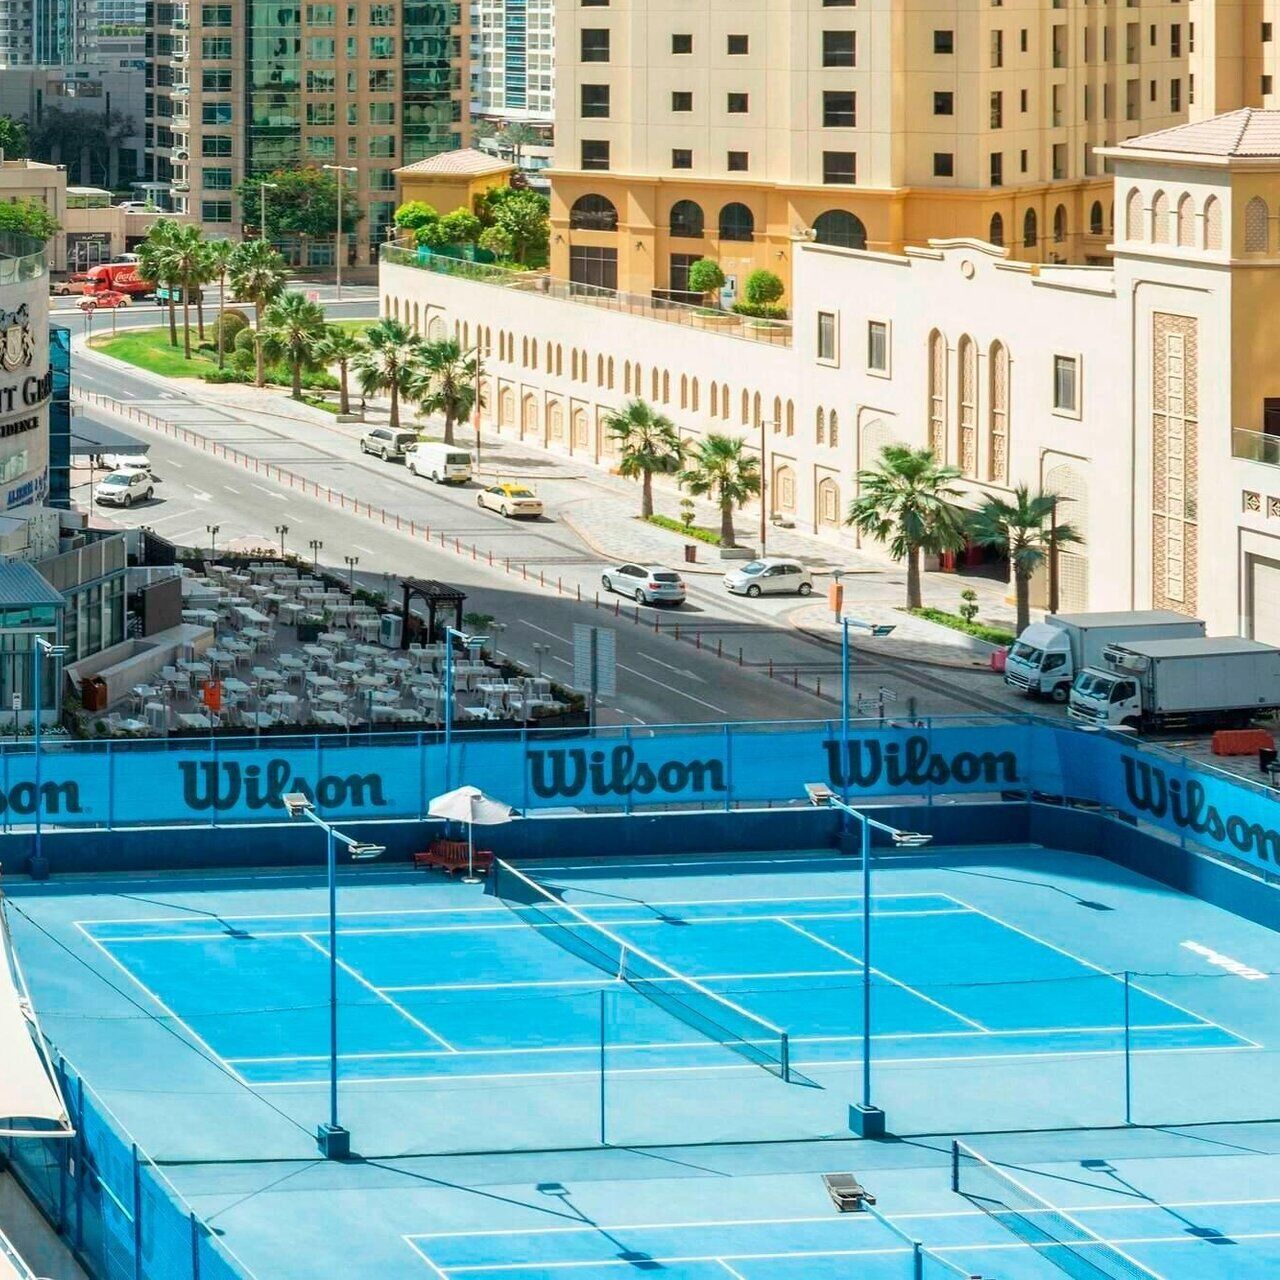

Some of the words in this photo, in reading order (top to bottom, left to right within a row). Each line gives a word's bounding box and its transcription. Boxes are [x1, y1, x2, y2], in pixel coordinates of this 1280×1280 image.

[178, 758, 388, 811] Wilson
[526, 745, 728, 799] Wilson
[822, 735, 1020, 788] Wilson
[1121, 754, 1280, 866] Wilson
